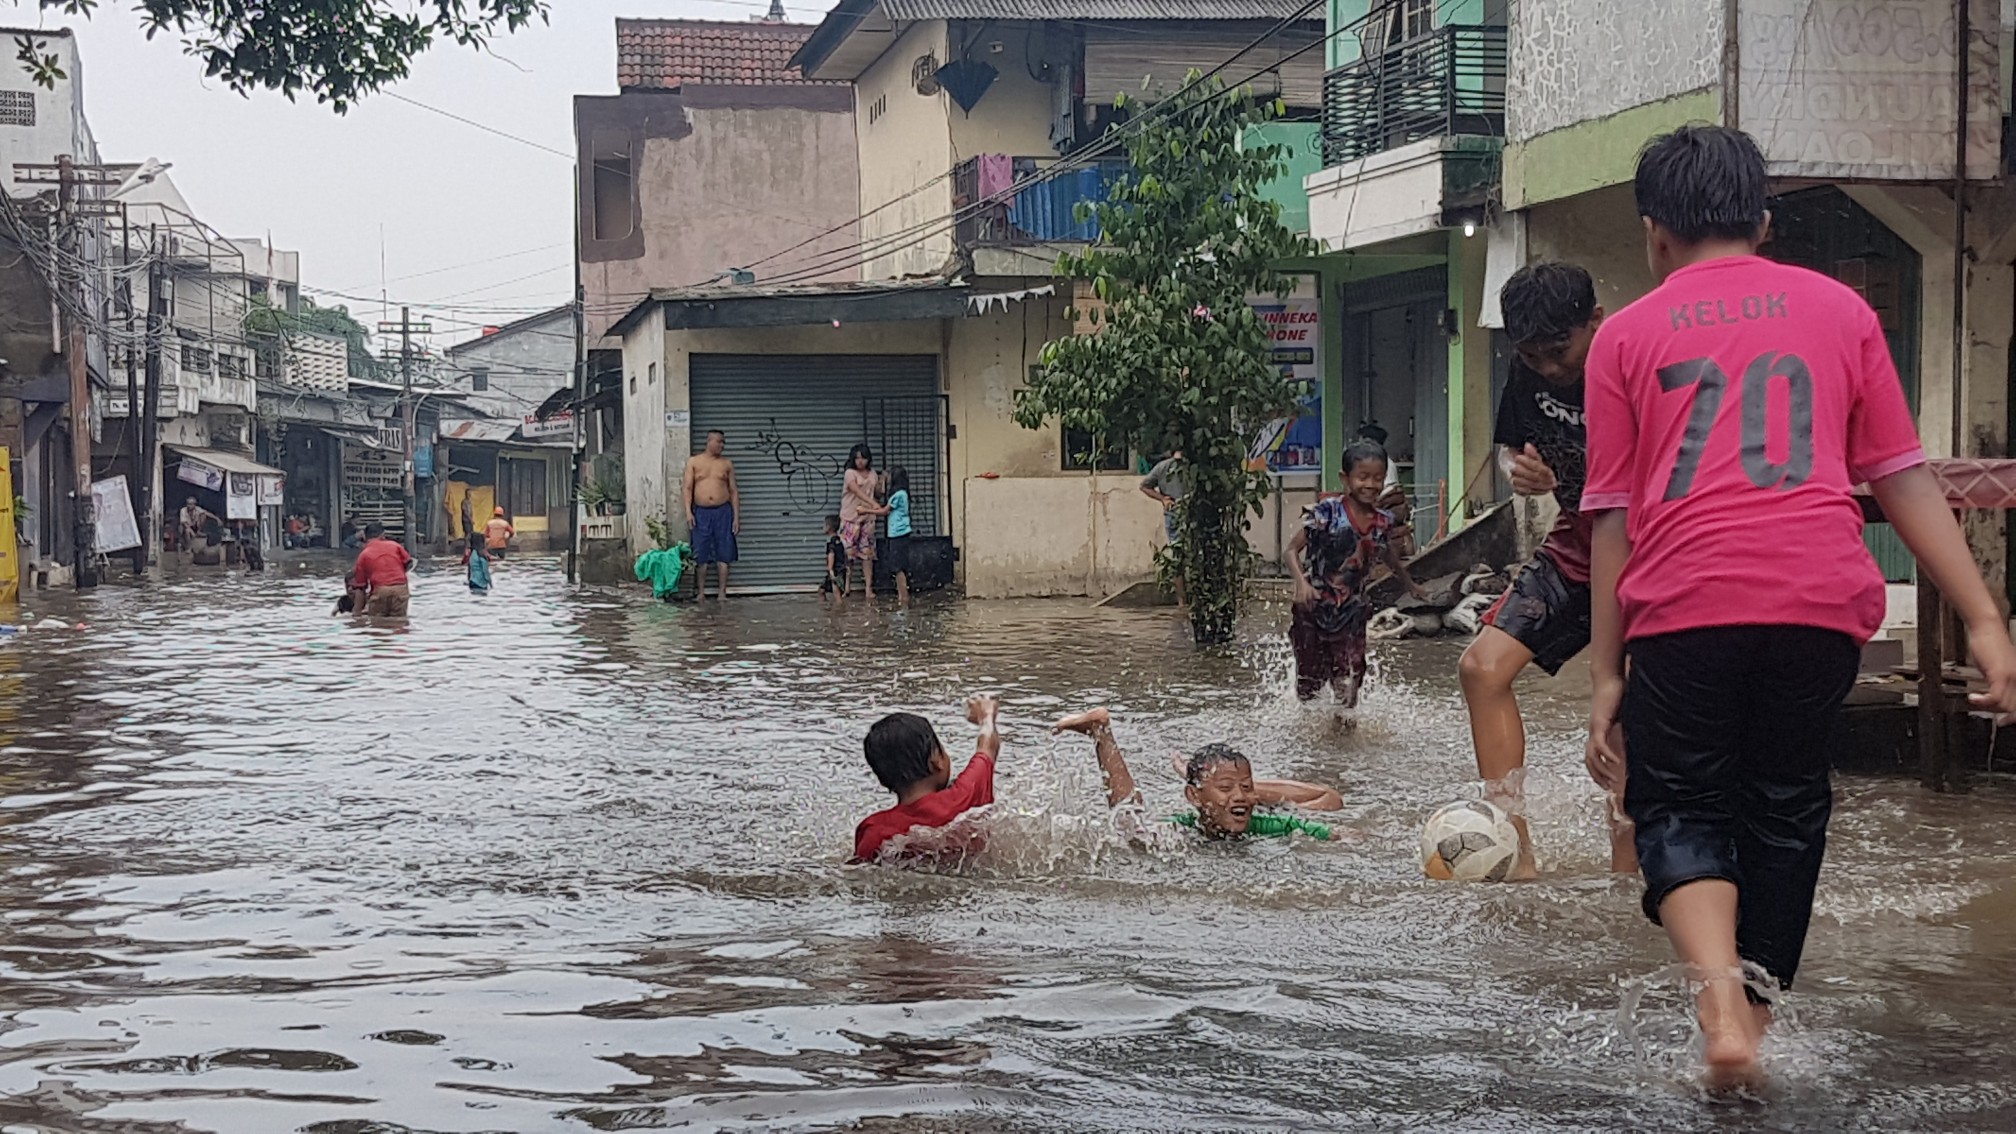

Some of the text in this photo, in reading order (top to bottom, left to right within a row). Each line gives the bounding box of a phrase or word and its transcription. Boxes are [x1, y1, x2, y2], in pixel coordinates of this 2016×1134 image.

[1262, 312, 1318, 323] INNEKA
[1669, 291, 1788, 331] KELOK
[1266, 329, 1308, 341] HONE
[1656, 351, 1813, 503] 70
